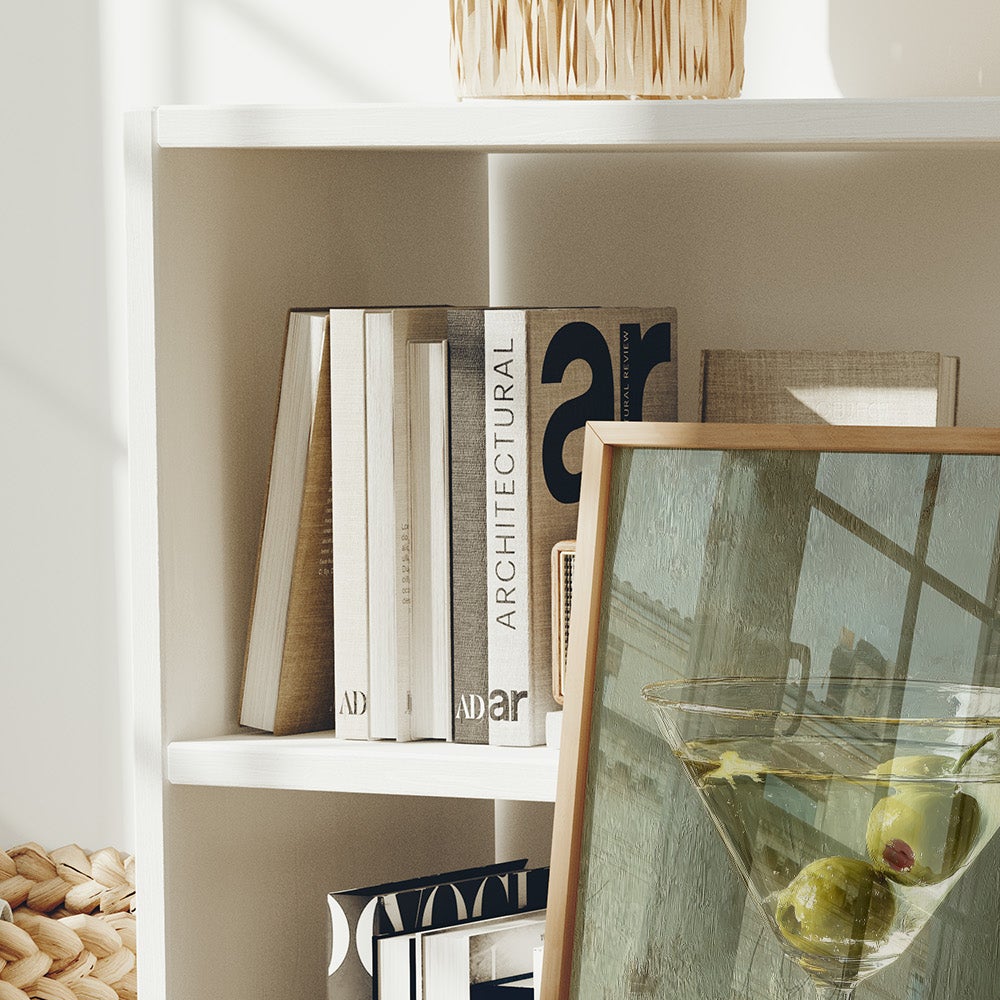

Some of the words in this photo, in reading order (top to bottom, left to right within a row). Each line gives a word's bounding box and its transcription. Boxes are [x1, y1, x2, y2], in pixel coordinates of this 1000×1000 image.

[541, 321, 671, 504] ar
[493, 338, 516, 630] ARCHITECTURAL
[339, 690, 367, 715] AD
[455, 694, 486, 720] AD
[489, 689, 528, 722] ar
